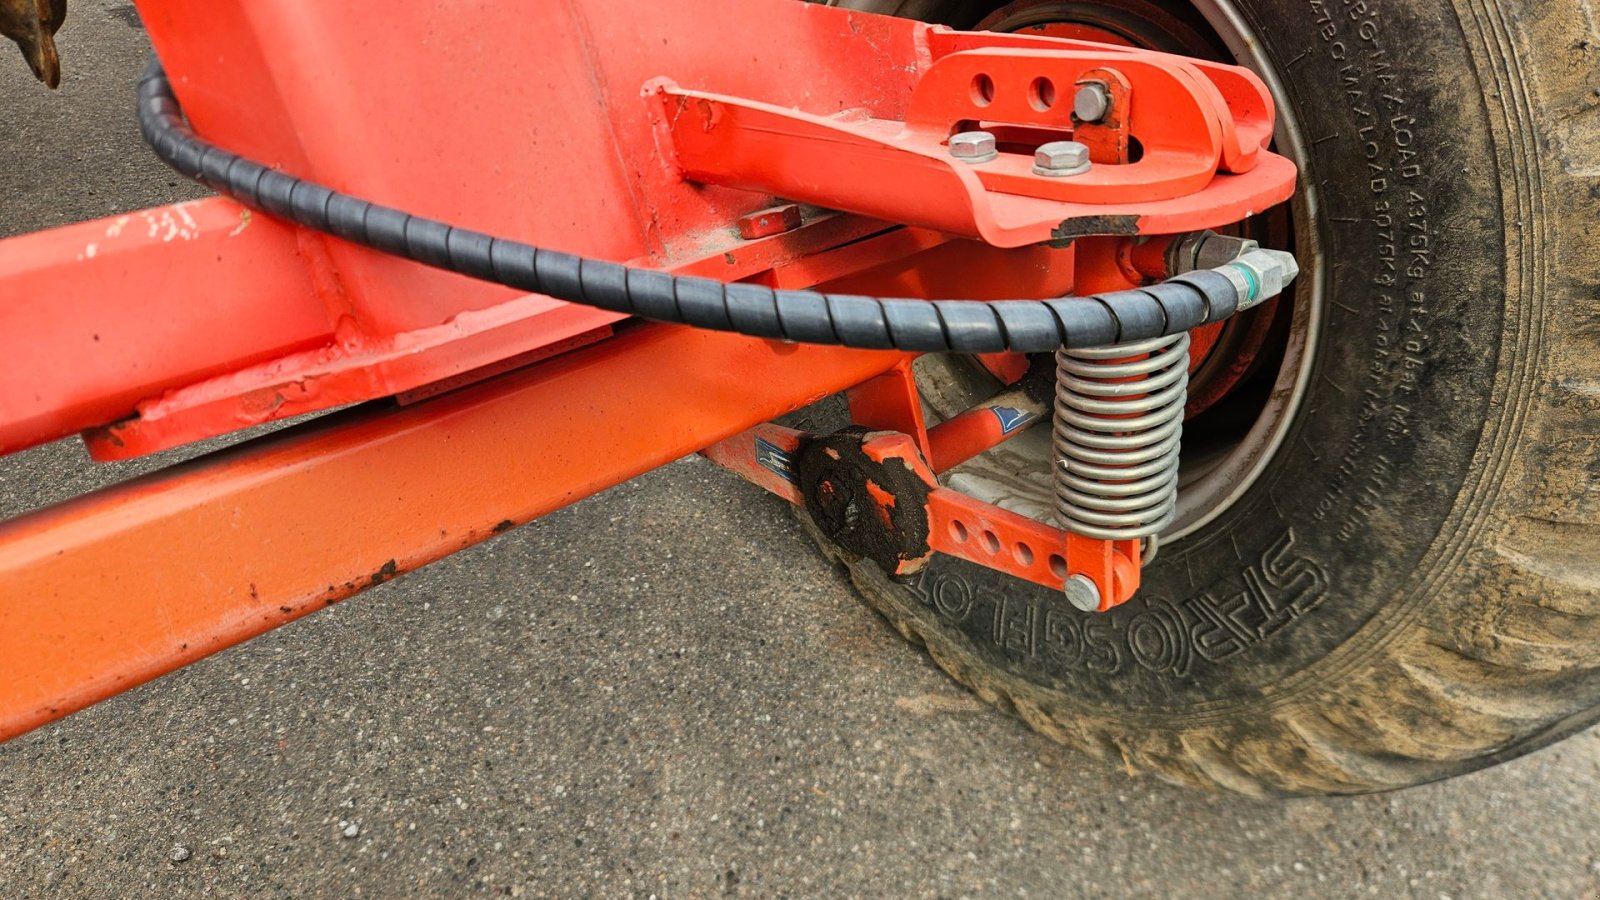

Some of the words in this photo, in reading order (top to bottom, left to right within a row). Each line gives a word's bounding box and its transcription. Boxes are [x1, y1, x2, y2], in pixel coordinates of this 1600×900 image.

[1359, 126, 1387, 193] LOAD
[1374, 201, 1396, 287] 3075Kg
[1390, 115, 1420, 178] LOAD
[1406, 191, 1430, 279] 4375Kg
